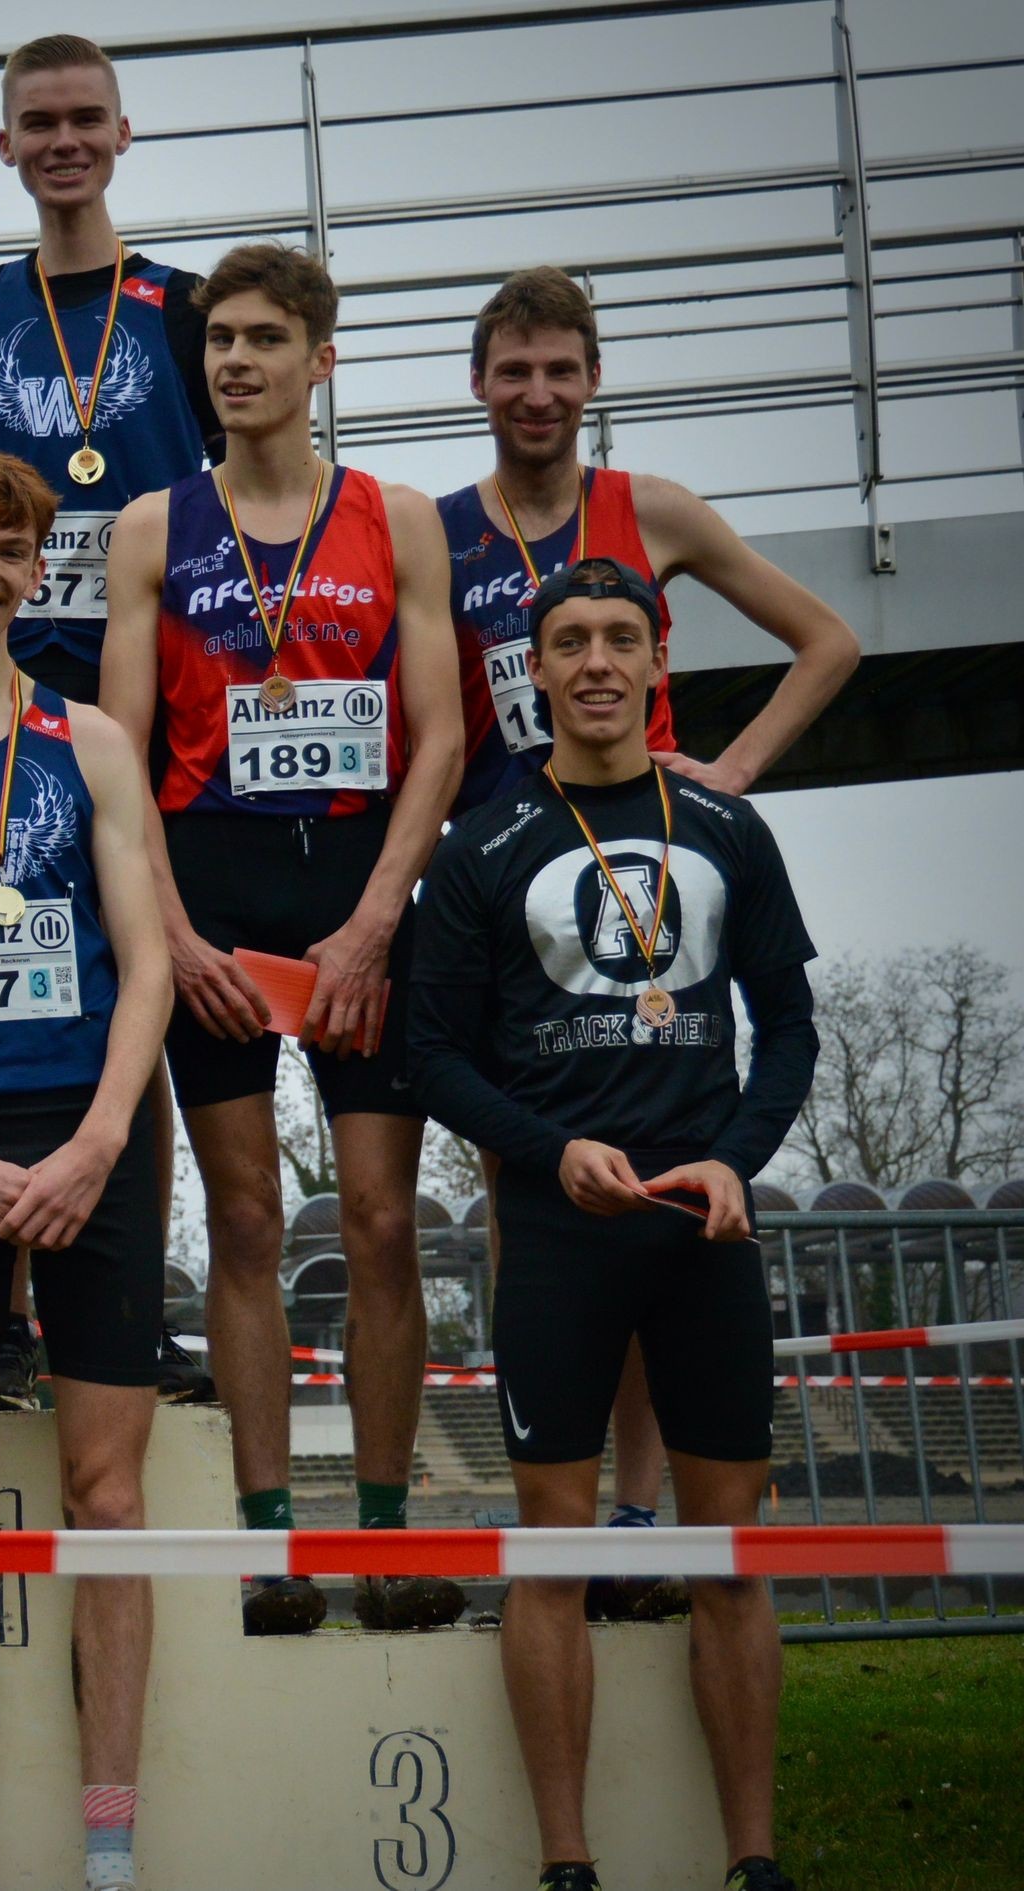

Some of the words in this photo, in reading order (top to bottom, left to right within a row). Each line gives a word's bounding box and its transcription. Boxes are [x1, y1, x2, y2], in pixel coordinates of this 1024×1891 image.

[21, 376, 101, 438] W
[42, 530, 91, 550] anz
[170, 552, 224, 577] jogging
[191, 561, 224, 578] plus
[26, 573, 83, 607] 57
[188, 578, 253, 615] RFC
[291, 572, 374, 606] Liège
[463, 570, 522, 612] RFC
[204, 617, 361, 656] athltisme
[489, 652, 527, 686] All
[231, 698, 336, 723] Allanz
[239, 742, 332, 782] 189
[343, 745, 357, 771] 3
[678, 787, 722, 818] CRAFT
[480, 807, 543, 855] joggingplus
[589, 864, 674, 961] A
[32, 971, 48, 998] 3
[533, 1013, 628, 1056] TRACK
[630, 1012, 655, 1045] &
[659, 1012, 721, 1047] FIELD
[369, 1730, 456, 1891] 3
